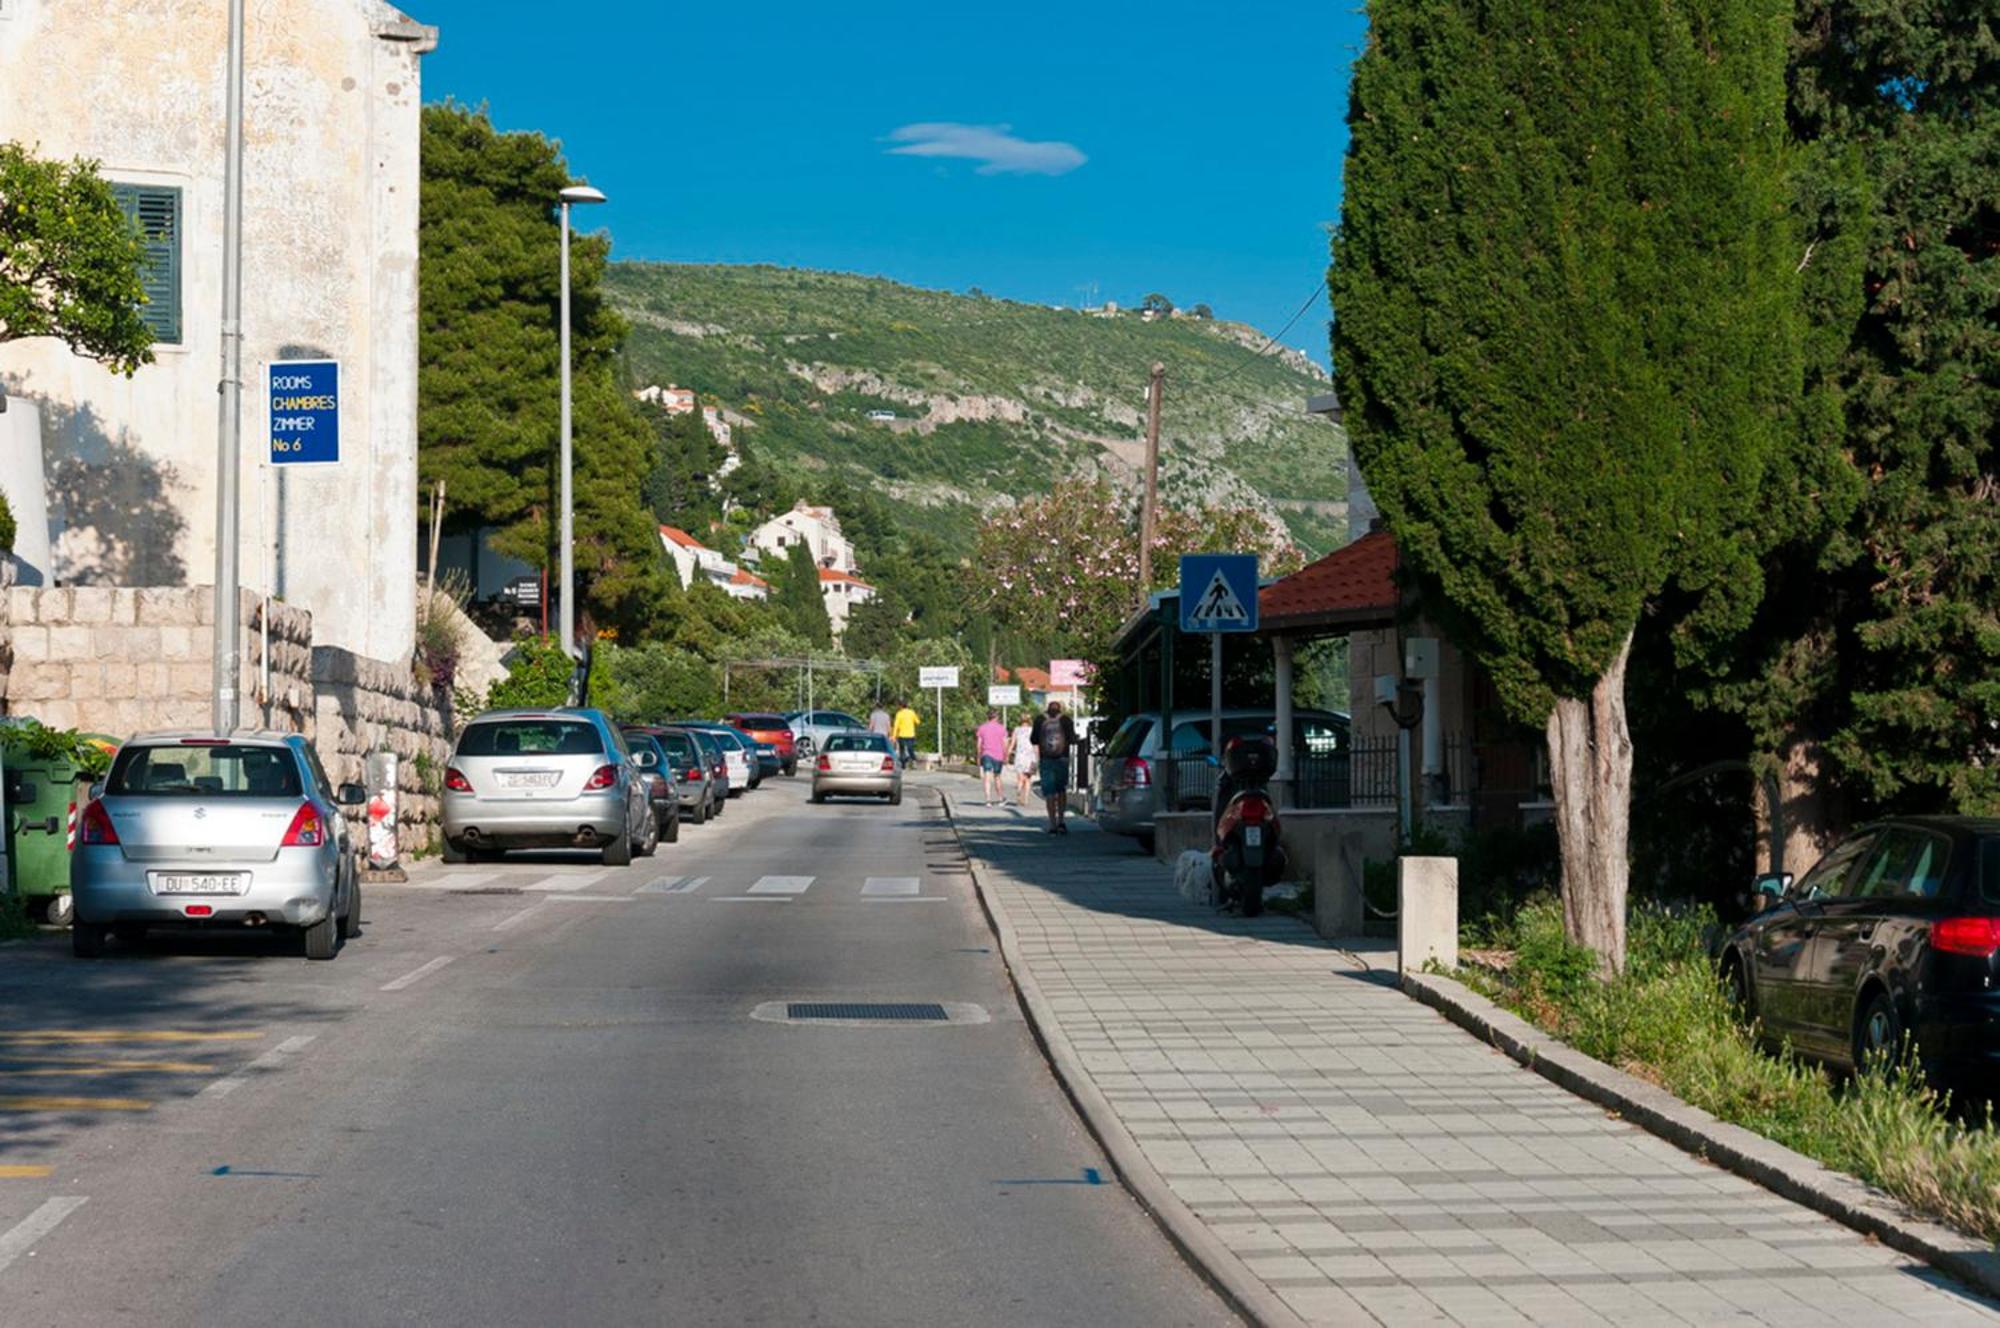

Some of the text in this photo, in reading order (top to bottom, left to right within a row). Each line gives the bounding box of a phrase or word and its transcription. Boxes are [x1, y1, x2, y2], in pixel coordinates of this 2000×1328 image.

[272, 375, 313, 390] ROOMS
[272, 395, 336, 411] CHAMBRES
[273, 416, 315, 432] ZIMMER
[272, 437, 302, 452] No 6
[166, 877, 182, 891] DU
